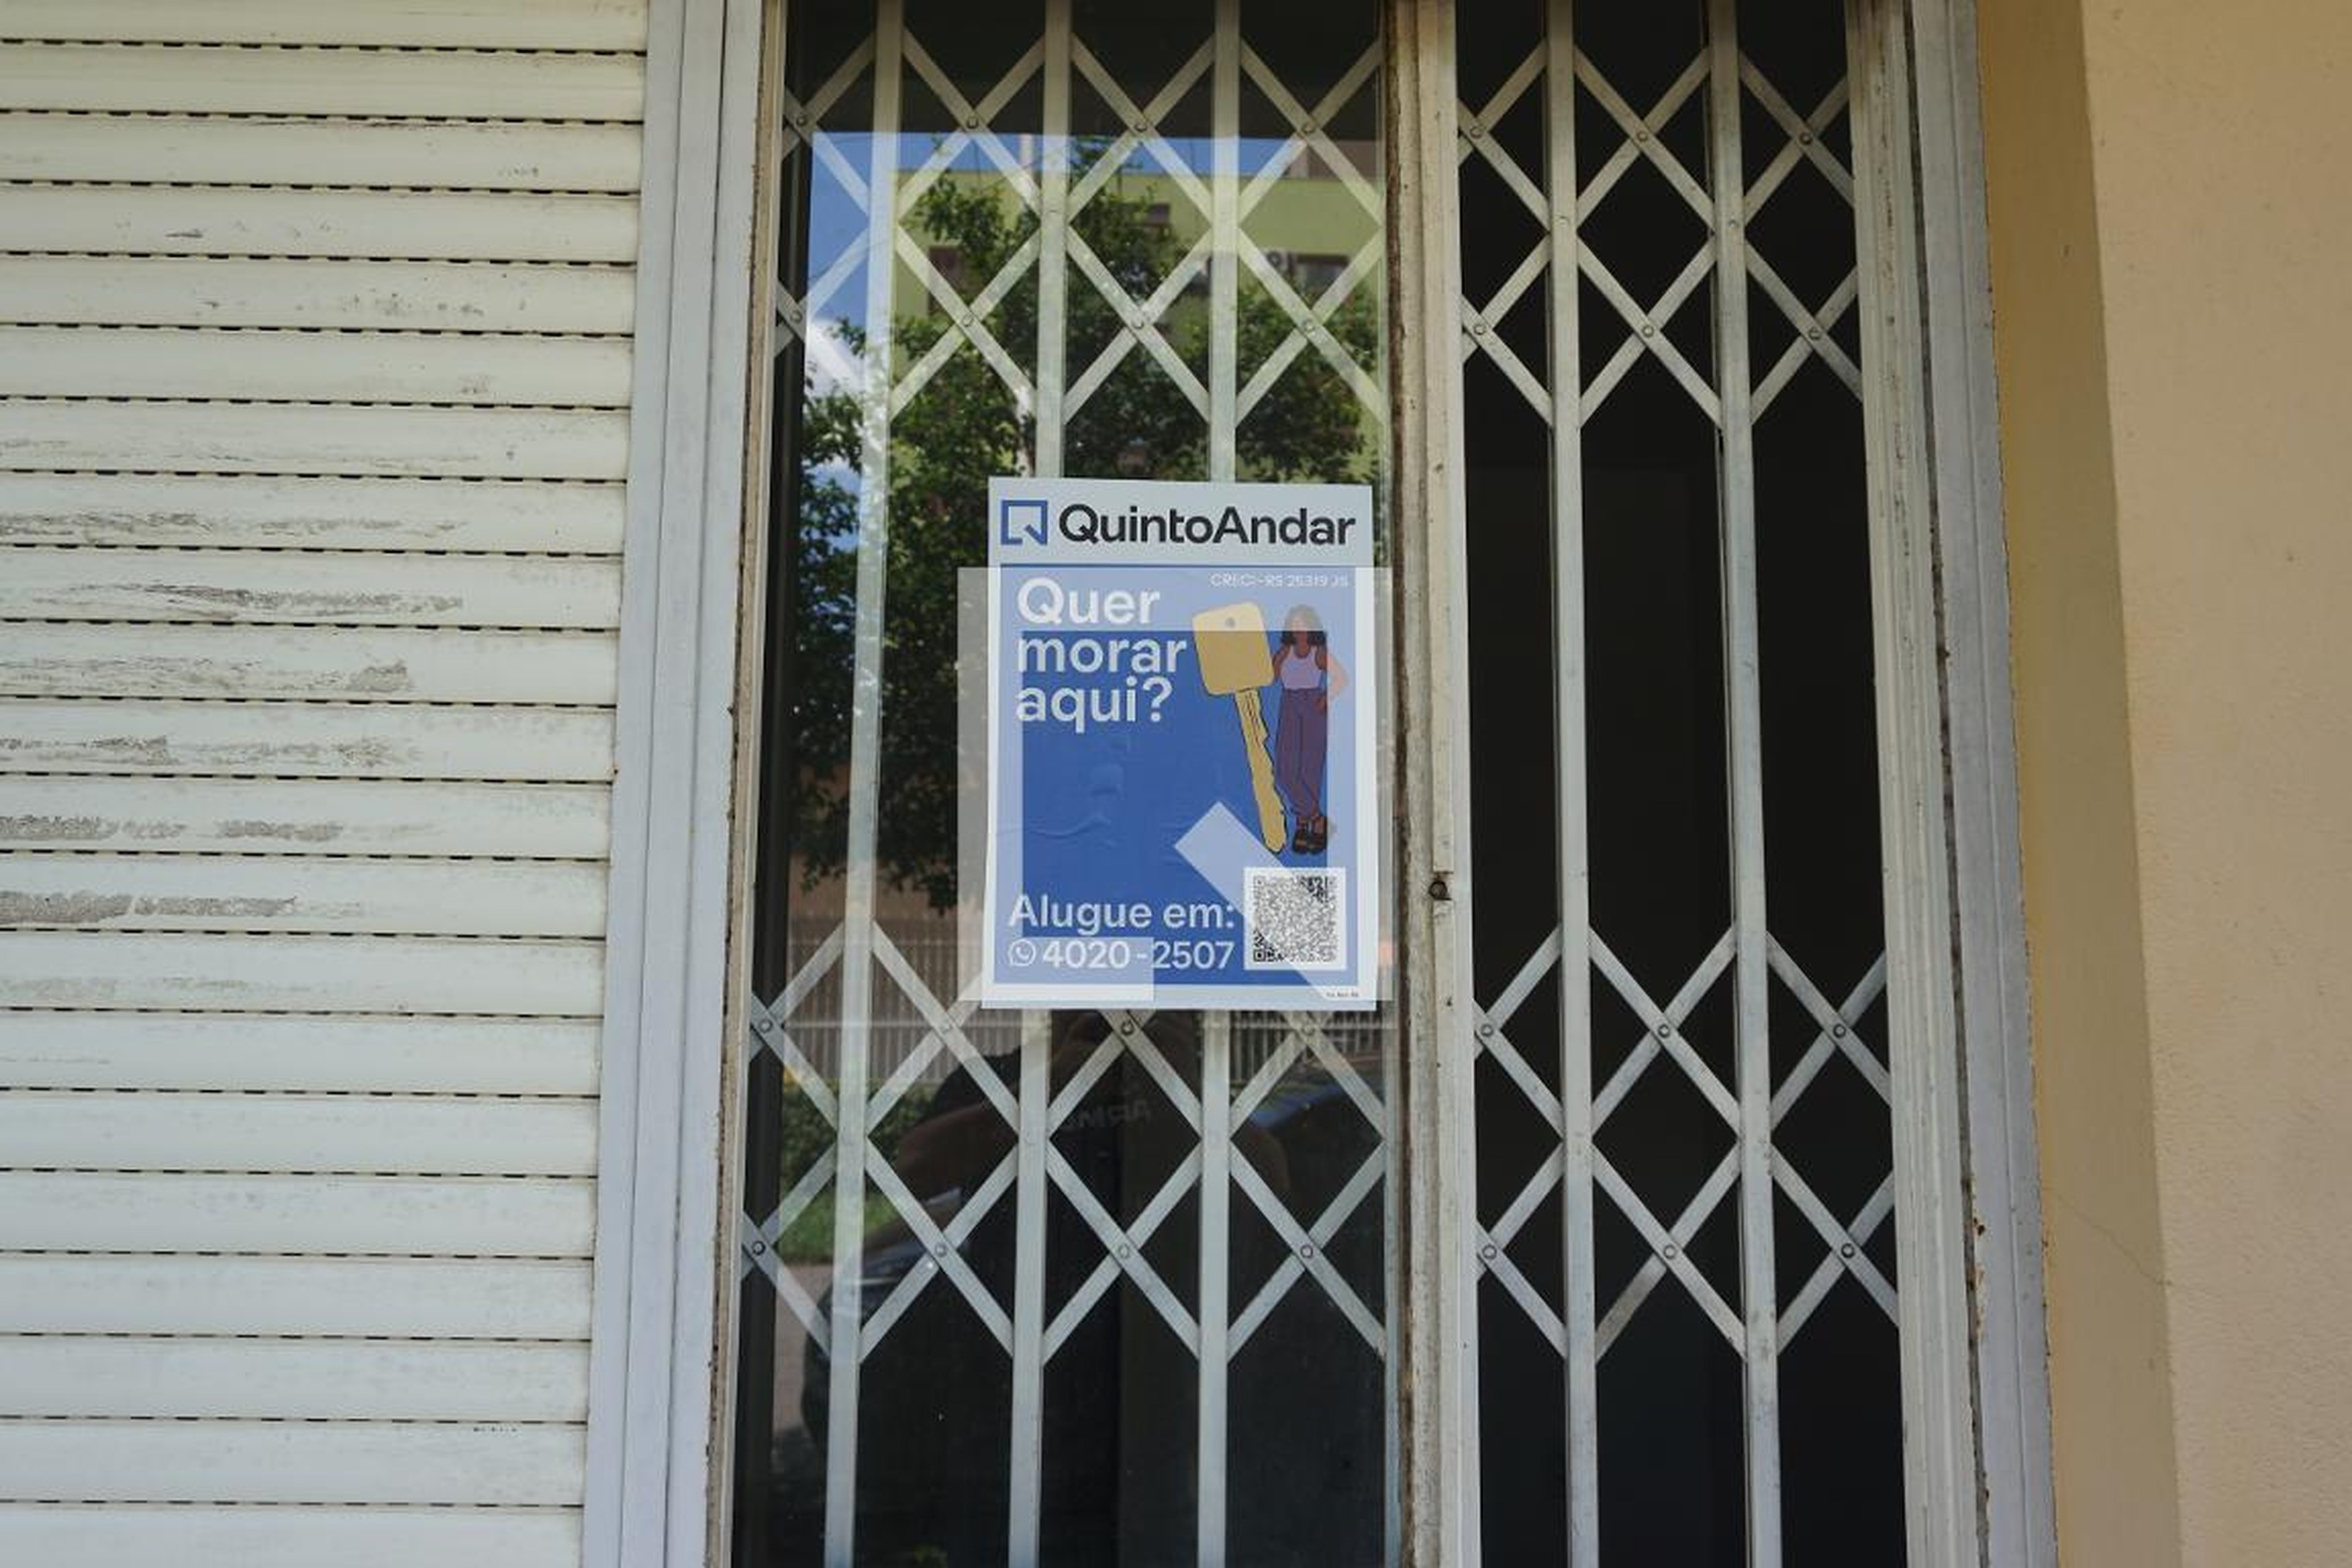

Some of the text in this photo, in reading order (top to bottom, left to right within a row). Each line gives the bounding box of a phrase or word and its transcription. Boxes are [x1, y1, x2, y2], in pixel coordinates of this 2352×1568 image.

[1058, 503, 1356, 545] QuintoAndar
[1017, 577, 1160, 625] Quer
[1018, 636, 1187, 674] morar
[1016, 676, 1173, 734] aqui?
[1008, 894, 1235, 936] Alugue em:
[1041, 940, 1235, 970] 4020-2507
